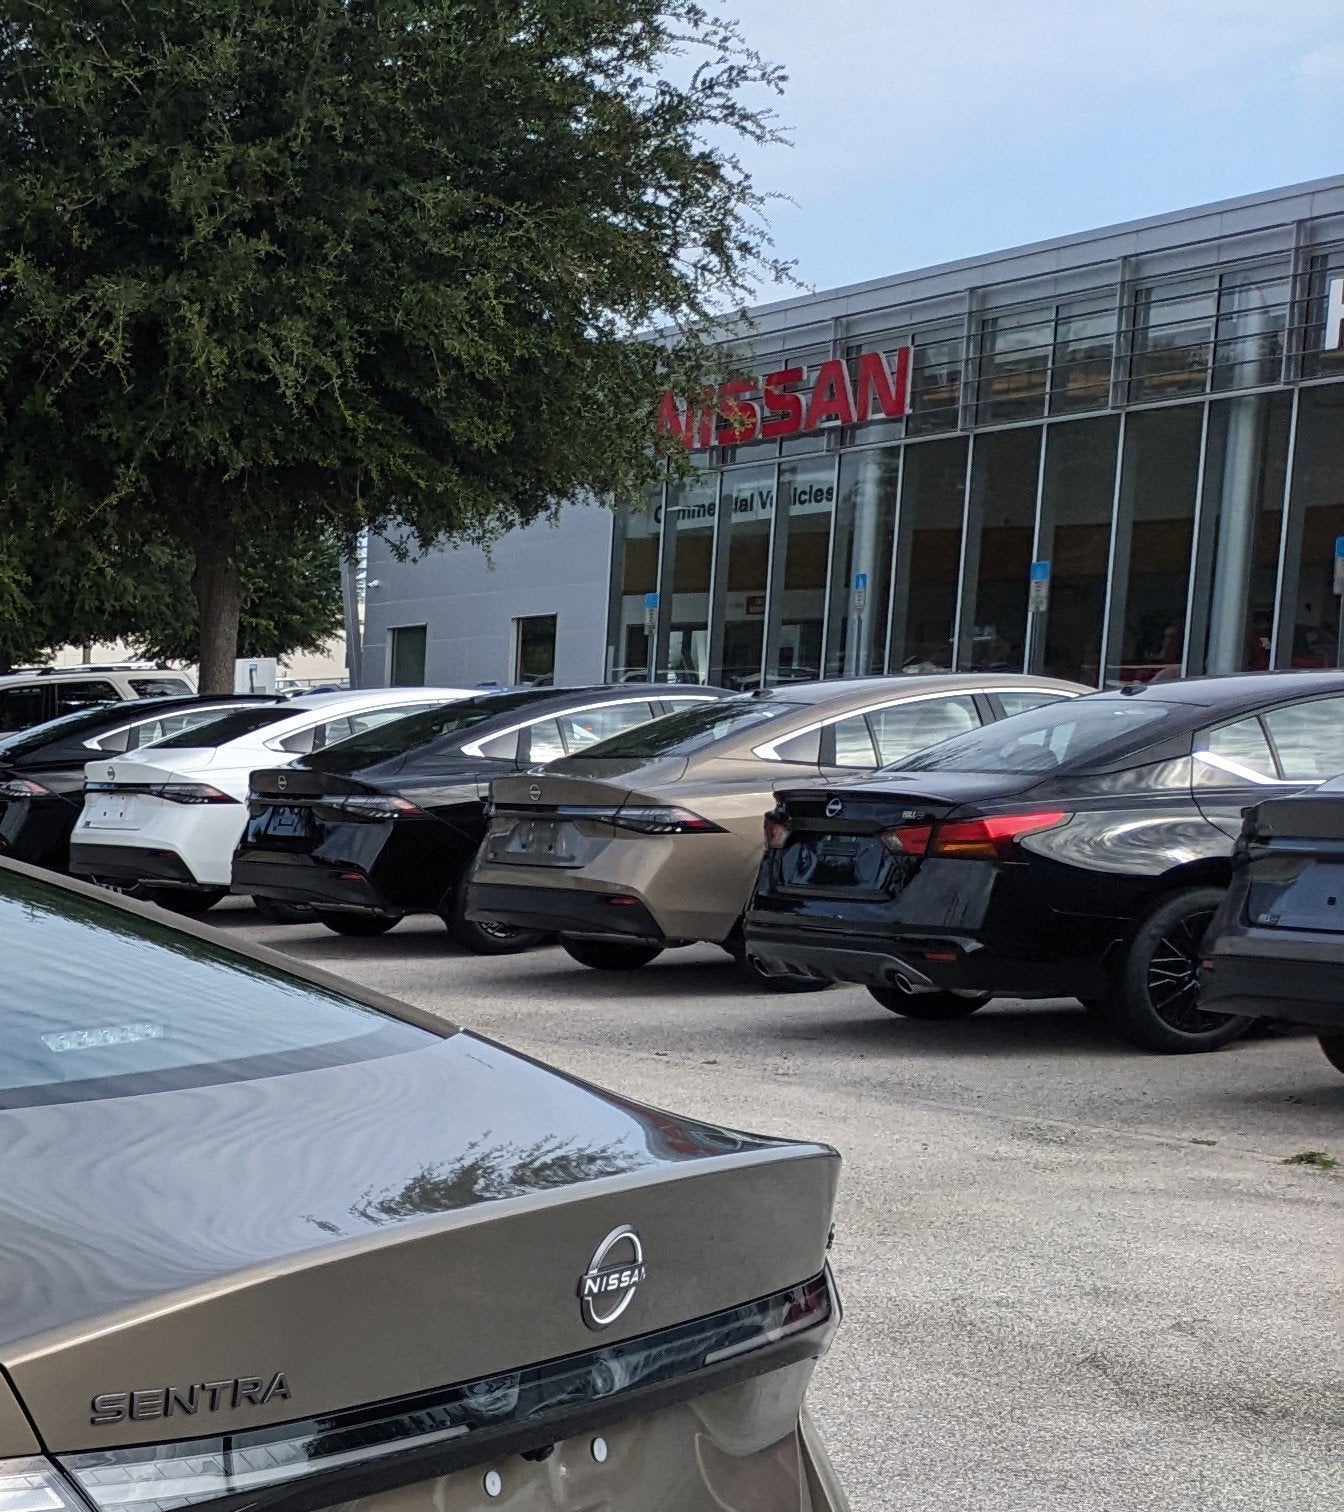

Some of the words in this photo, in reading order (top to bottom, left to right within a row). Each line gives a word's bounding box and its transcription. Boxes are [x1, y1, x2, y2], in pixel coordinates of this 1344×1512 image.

[657, 346, 912, 449] NISSAN
[654, 492, 754, 524] Cmmeial
[584, 1266, 647, 1295] NISSAN
[90, 1370, 292, 1425] SENTRA
